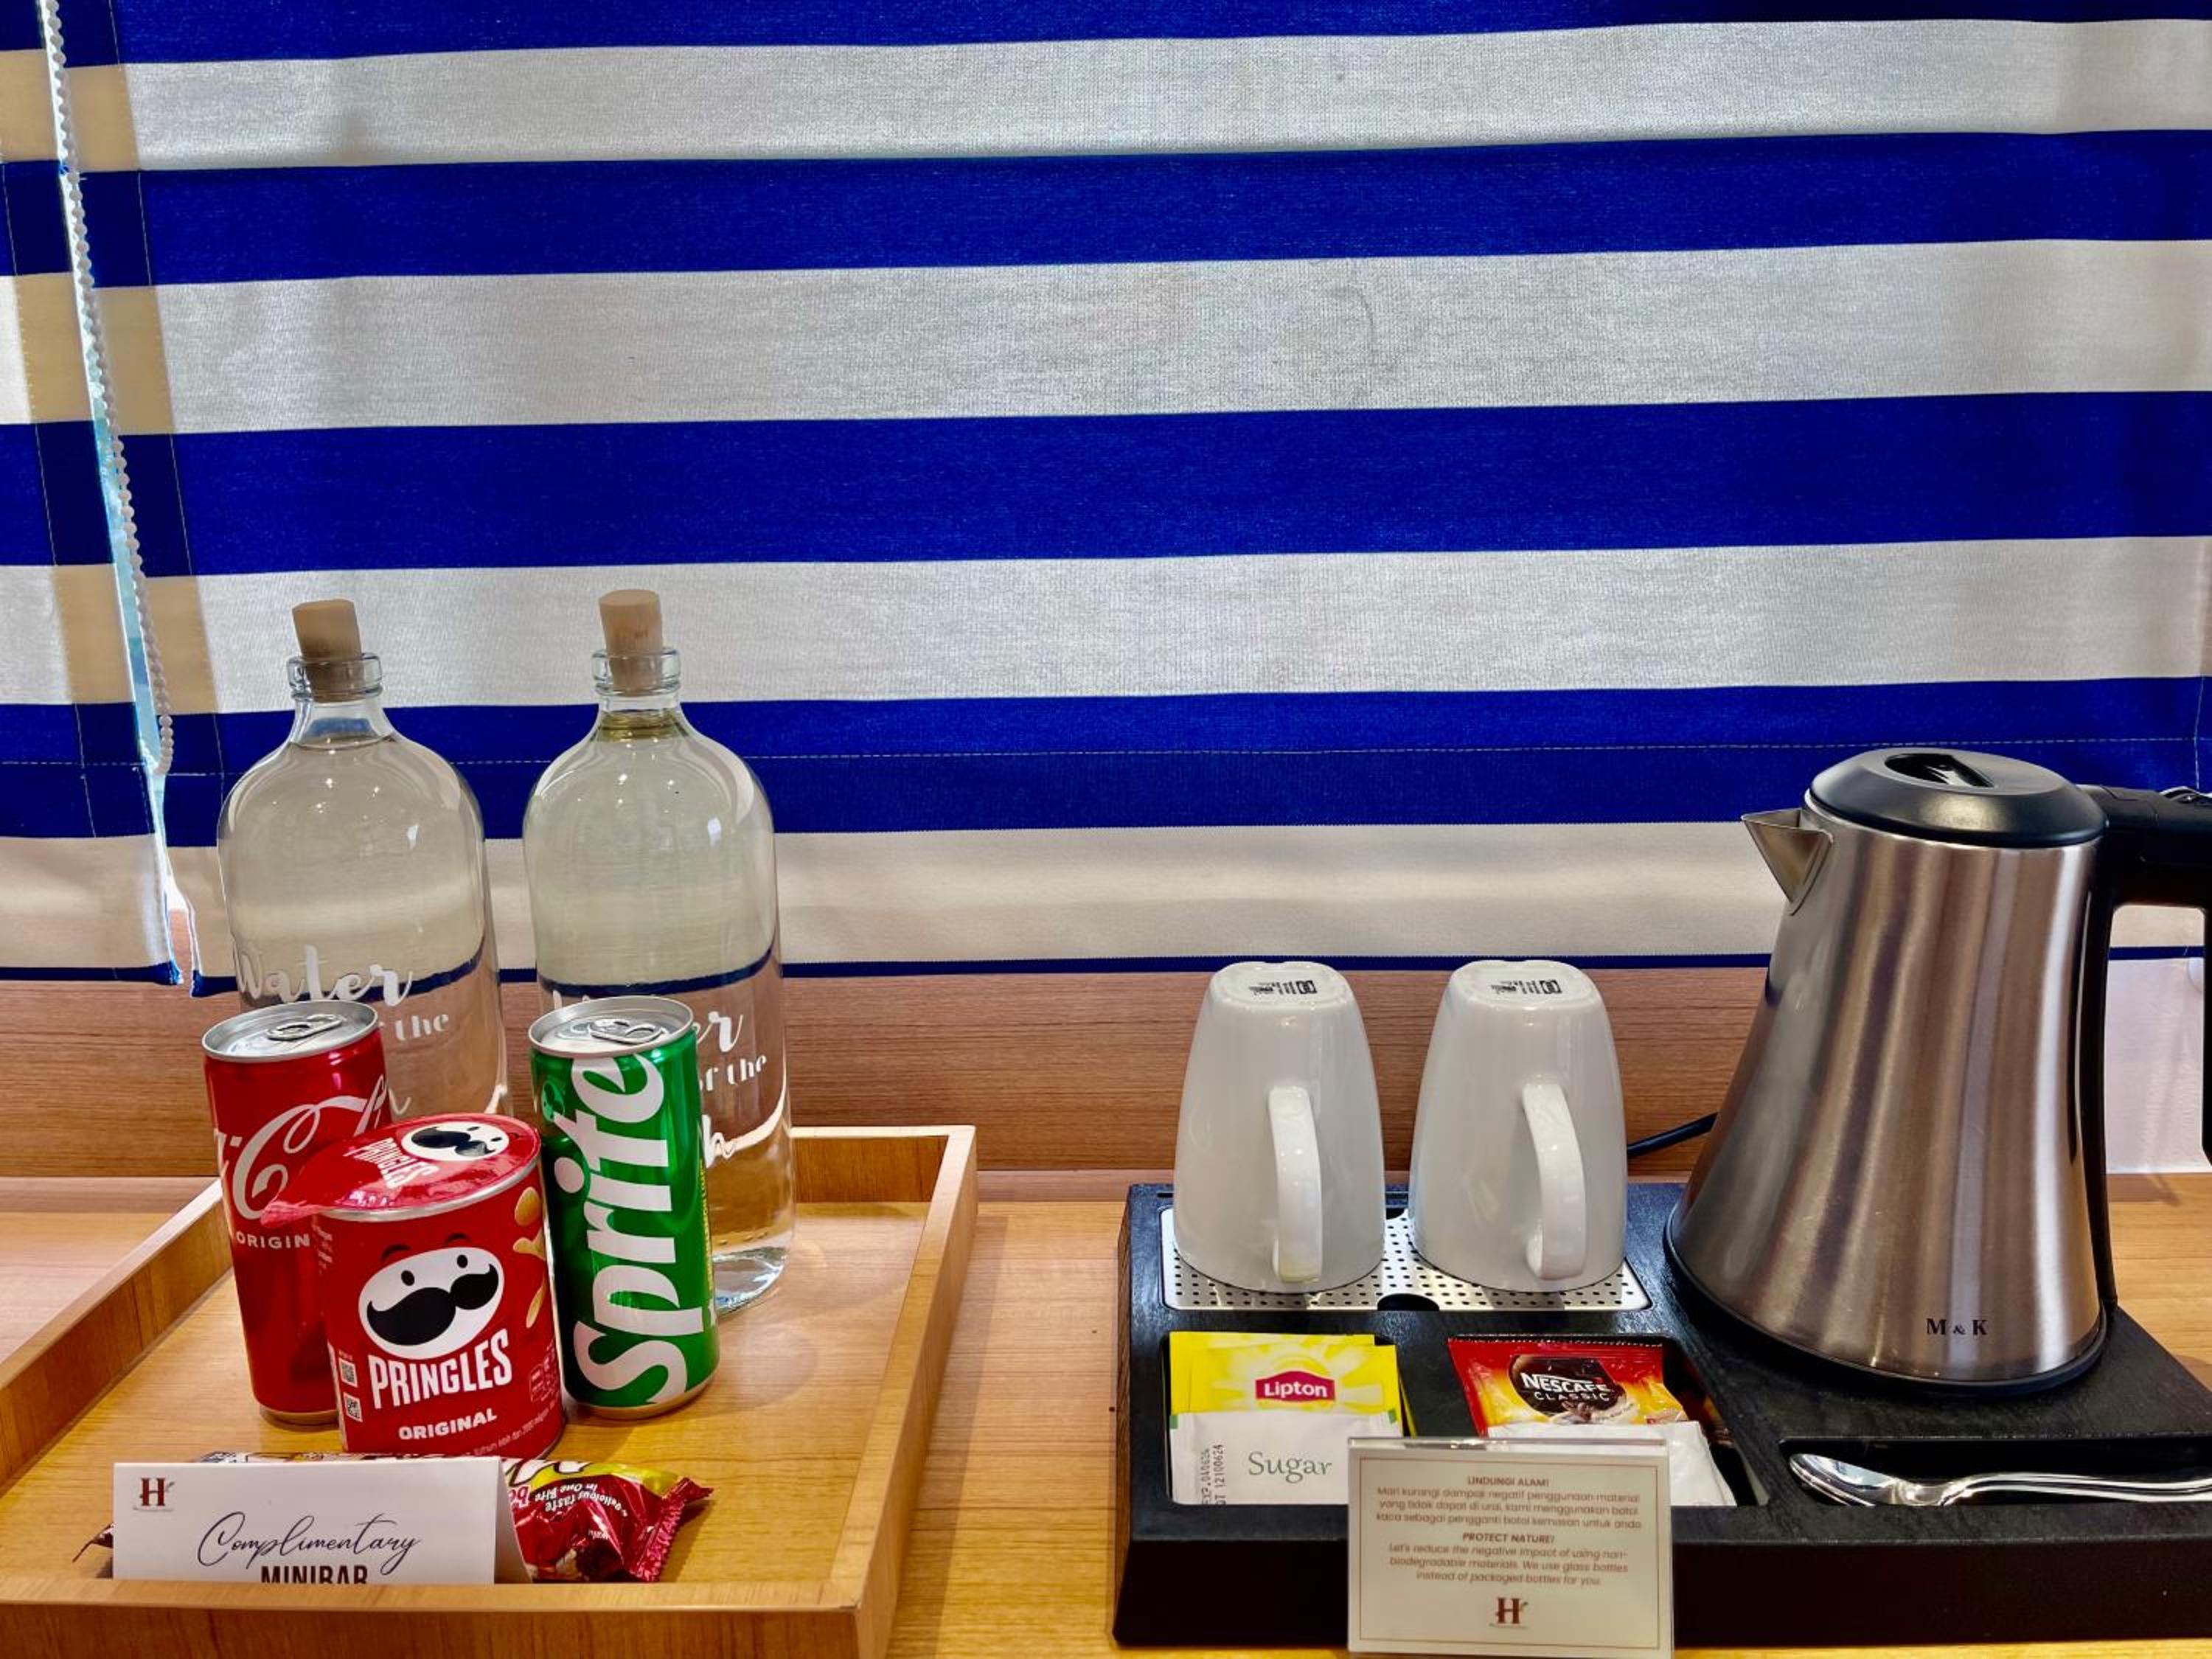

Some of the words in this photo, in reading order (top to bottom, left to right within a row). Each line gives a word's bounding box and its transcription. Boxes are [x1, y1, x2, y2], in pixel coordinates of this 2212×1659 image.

[395, 1013, 449, 1040] the
[727, 1055, 767, 1085] the
[236, 1231, 310, 1249] ORIGIN
[1926, 1318, 1947, 1335] M
[1952, 1324, 1966, 1335] &
[1972, 1319, 1989, 1335] K
[368, 1328, 512, 1410] PRINGLES
[1264, 1381, 1328, 1399] Lipton
[1533, 1391, 1610, 1402] CLASSIC
[398, 1408, 498, 1440] ORIGINAL
[1248, 1450, 1333, 1484] Sugar
[1468, 1475, 1515, 1486] LINDUNGI
[140, 1477, 168, 1506] H
[1402, 1487, 1440, 1499] kurangi
[1489, 1490, 1525, 1501] negatif
[1527, 1491, 1593, 1503] penggunaan
[1380, 1500, 1405, 1511] yang
[1408, 1500, 1432, 1509] tidak
[1435, 1500, 1467, 1511] dapat
[1505, 1503, 1531, 1512] kami
[1533, 1504, 1610, 1516] menggunakan
[1377, 1512, 1402, 1521] kaca
[1403, 1512, 1445, 1524] sebagai
[1448, 1513, 1501, 1526] pengganti
[1503, 1514, 1529, 1526] botol
[1582, 1518, 1610, 1528] untuk
[198, 1511, 421, 1575] Complimentary
[1463, 1531, 1508, 1543] PROTECT
[1413, 1543, 1450, 1554] reduce
[1452, 1544, 1469, 1554] the
[1471, 1545, 1516, 1558] negative
[1520, 1548, 1557, 1559] impact
[1559, 1548, 1571, 1558] of
[1572, 1549, 1601, 1561] using
[1391, 1557, 1466, 1568] biodegradable
[1523, 1560, 1539, 1571] We
[1542, 1562, 1561, 1571] use
[1562, 1561, 1590, 1573] glass
[1593, 1562, 1629, 1573] bottles
[261, 1565, 369, 1585] MINIBAR
[1416, 1571, 1455, 1582] instead
[1457, 1571, 1469, 1582] of
[1470, 1572, 1523, 1585] packaged
[1526, 1573, 1561, 1585] bottles
[1564, 1574, 1578, 1585] for
[1496, 1597, 1523, 1624] H
